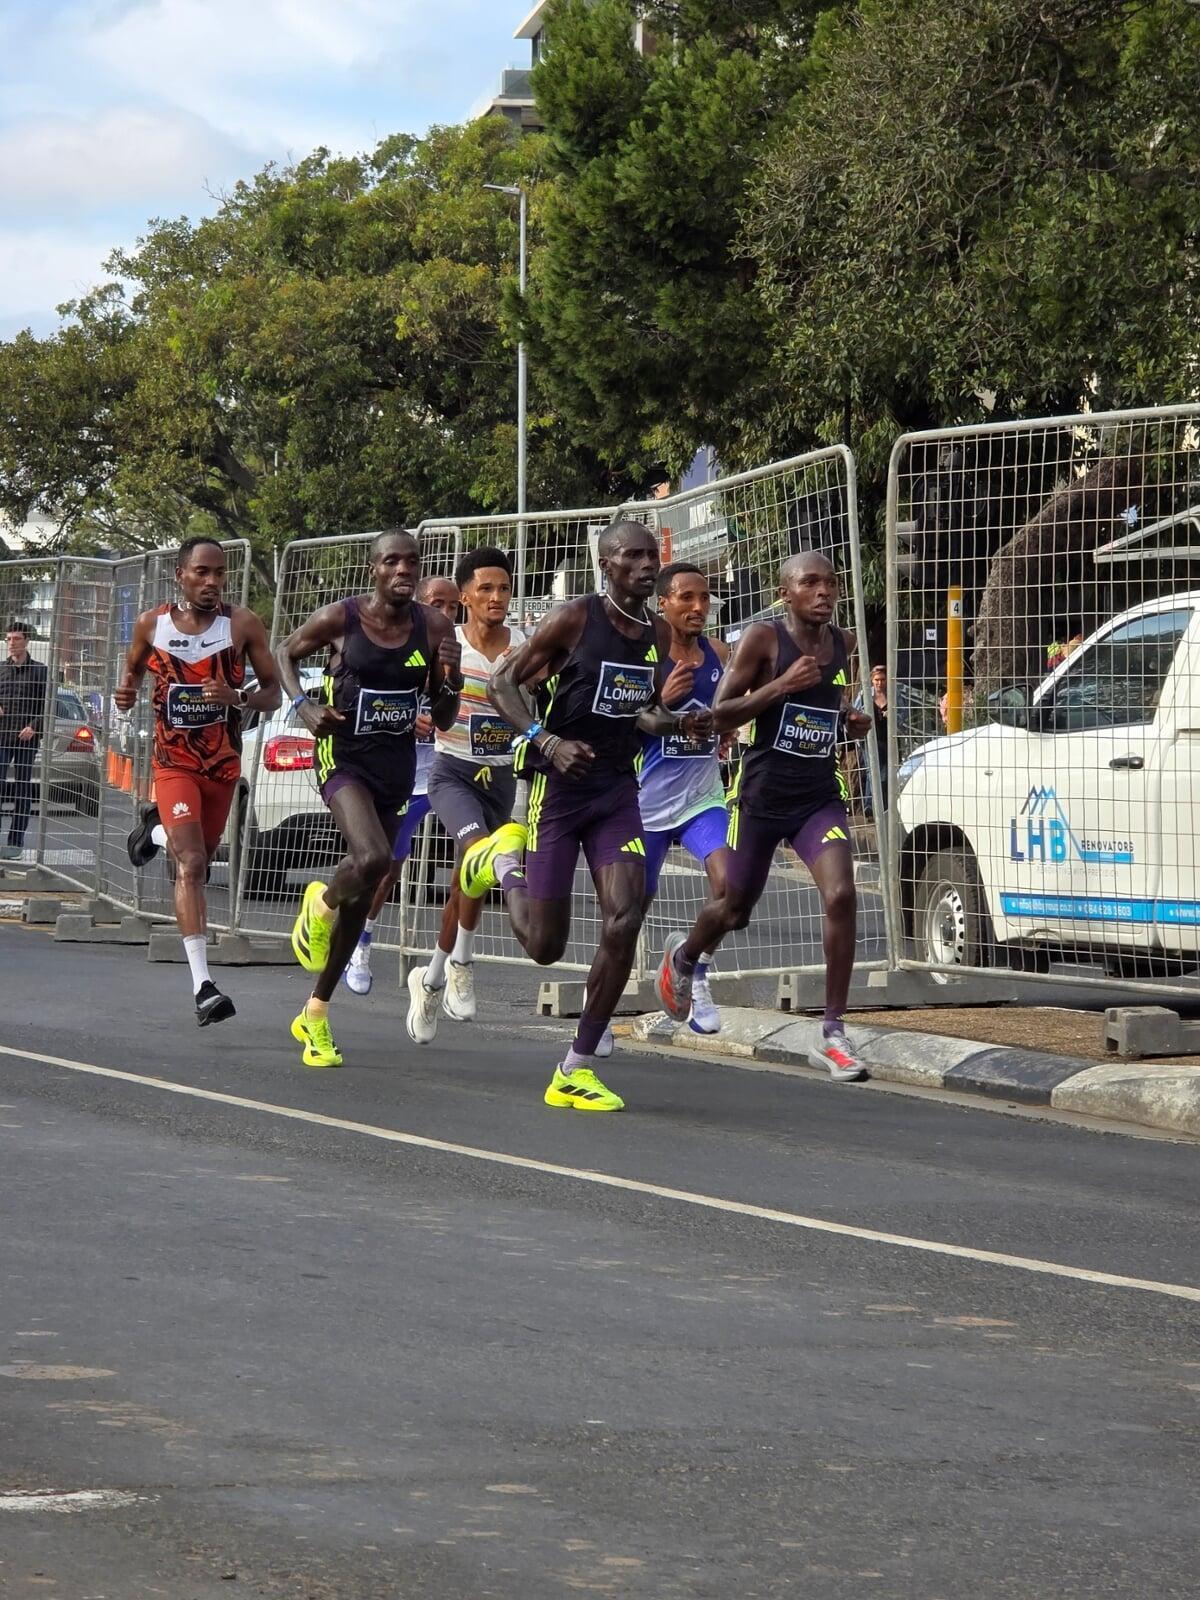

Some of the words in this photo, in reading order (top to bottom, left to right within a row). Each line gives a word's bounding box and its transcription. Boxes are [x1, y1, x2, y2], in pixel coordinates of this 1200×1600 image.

[953, 602, 959, 613] 4
[172, 703, 223, 713] MOHAMED
[599, 702, 613, 713] 52
[172, 716, 183, 725] 38
[364, 708, 415, 722] LANGAT
[360, 724, 373, 732] 48
[784, 724, 834, 743] BIWOTT
[473, 732, 512, 744] PACER
[683, 743, 703, 751] ELITE
[779, 739, 793, 750] 30
[799, 741, 817, 751] ELITE
[473, 747, 485, 755] 70
[665, 747, 678, 755] 25
[456, 822, 481, 840] HOKA
[1010, 818, 1067, 864] LHB
[1081, 839, 1134, 852] RENOVATORS
